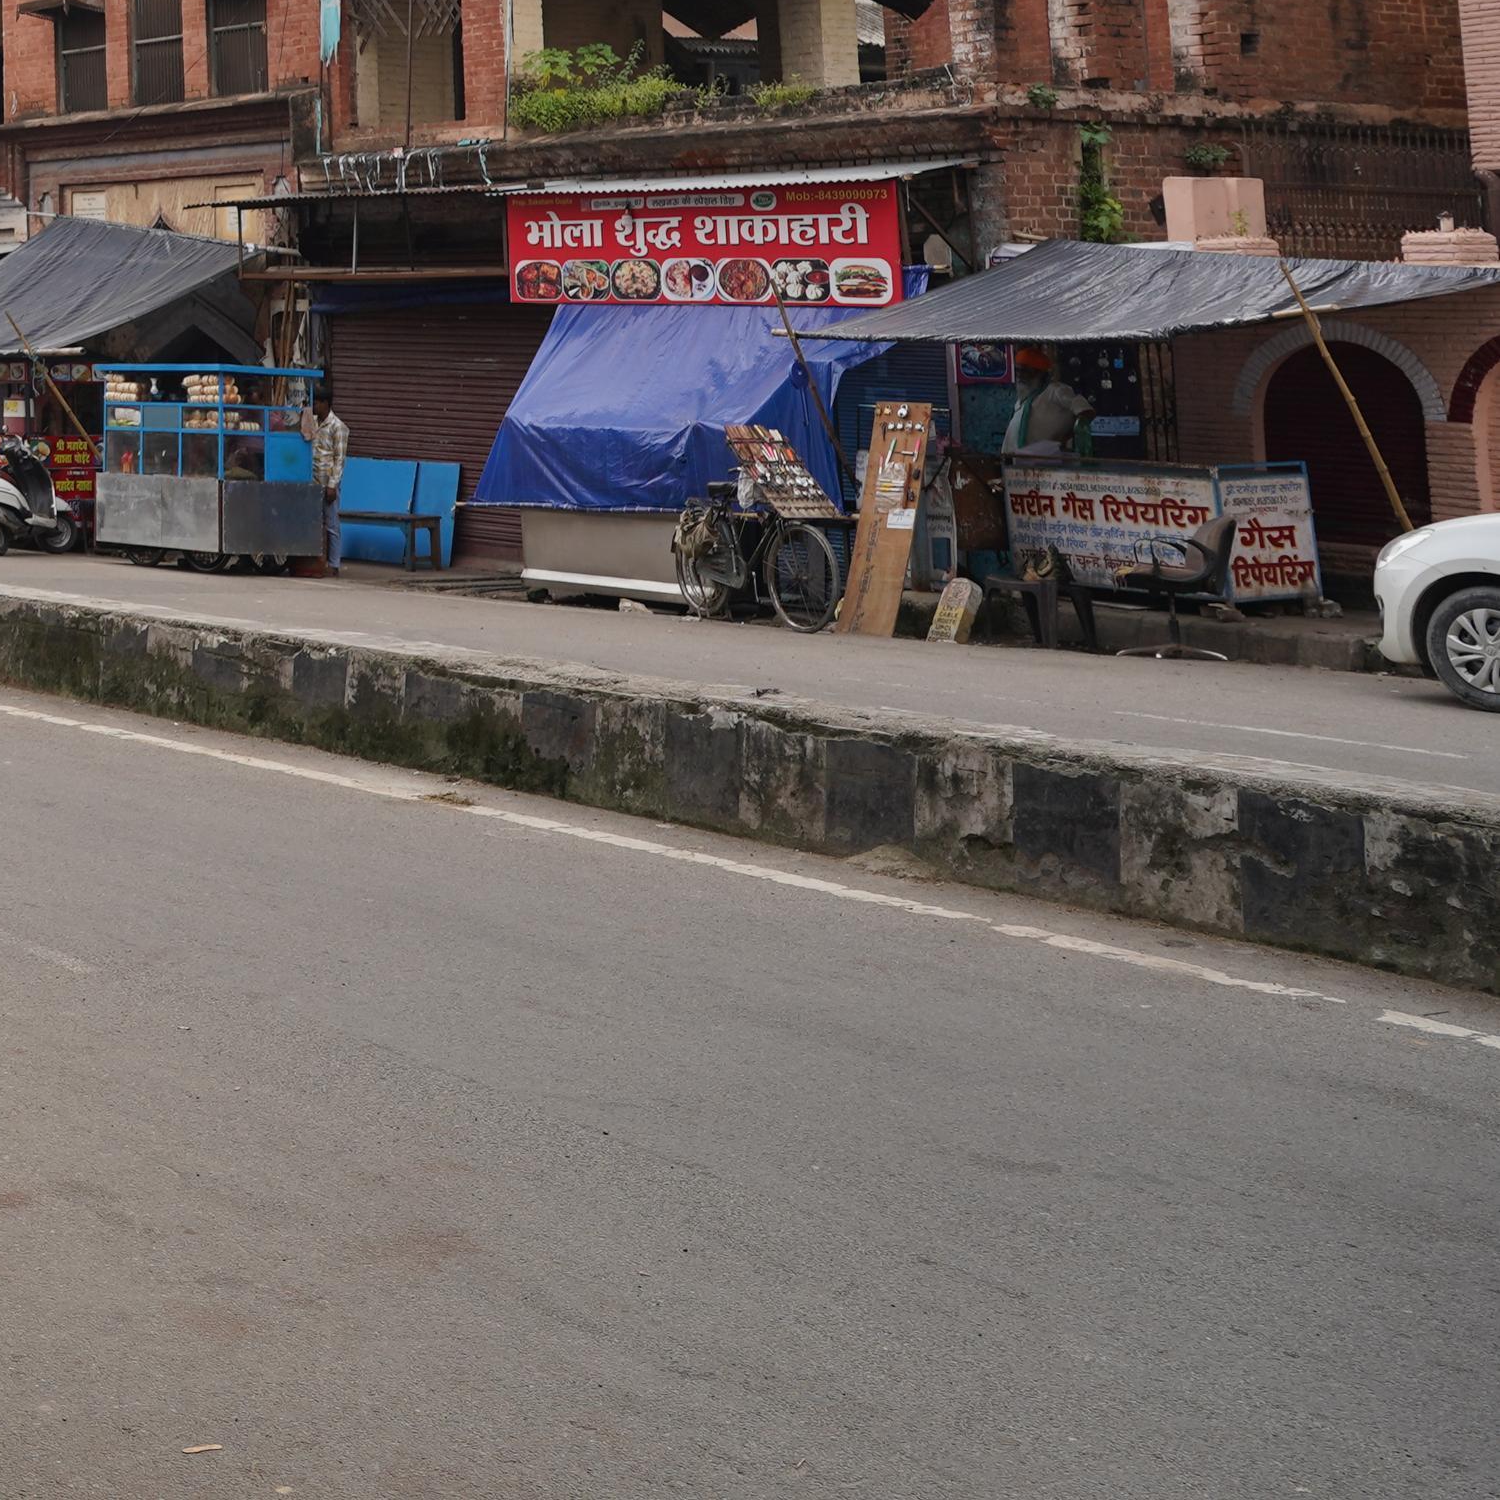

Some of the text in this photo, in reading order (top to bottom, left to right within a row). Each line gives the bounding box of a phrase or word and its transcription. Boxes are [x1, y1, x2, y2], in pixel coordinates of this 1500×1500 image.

[524, 202, 871, 258] भोला शुद्ध शाकाहारी
[1061, 491, 1095, 521] गैस
[1099, 494, 1211, 528] रिपेयरिंग
[1238, 517, 1297, 549] गैस
[1231, 554, 1315, 588] रिपेयरिंग
